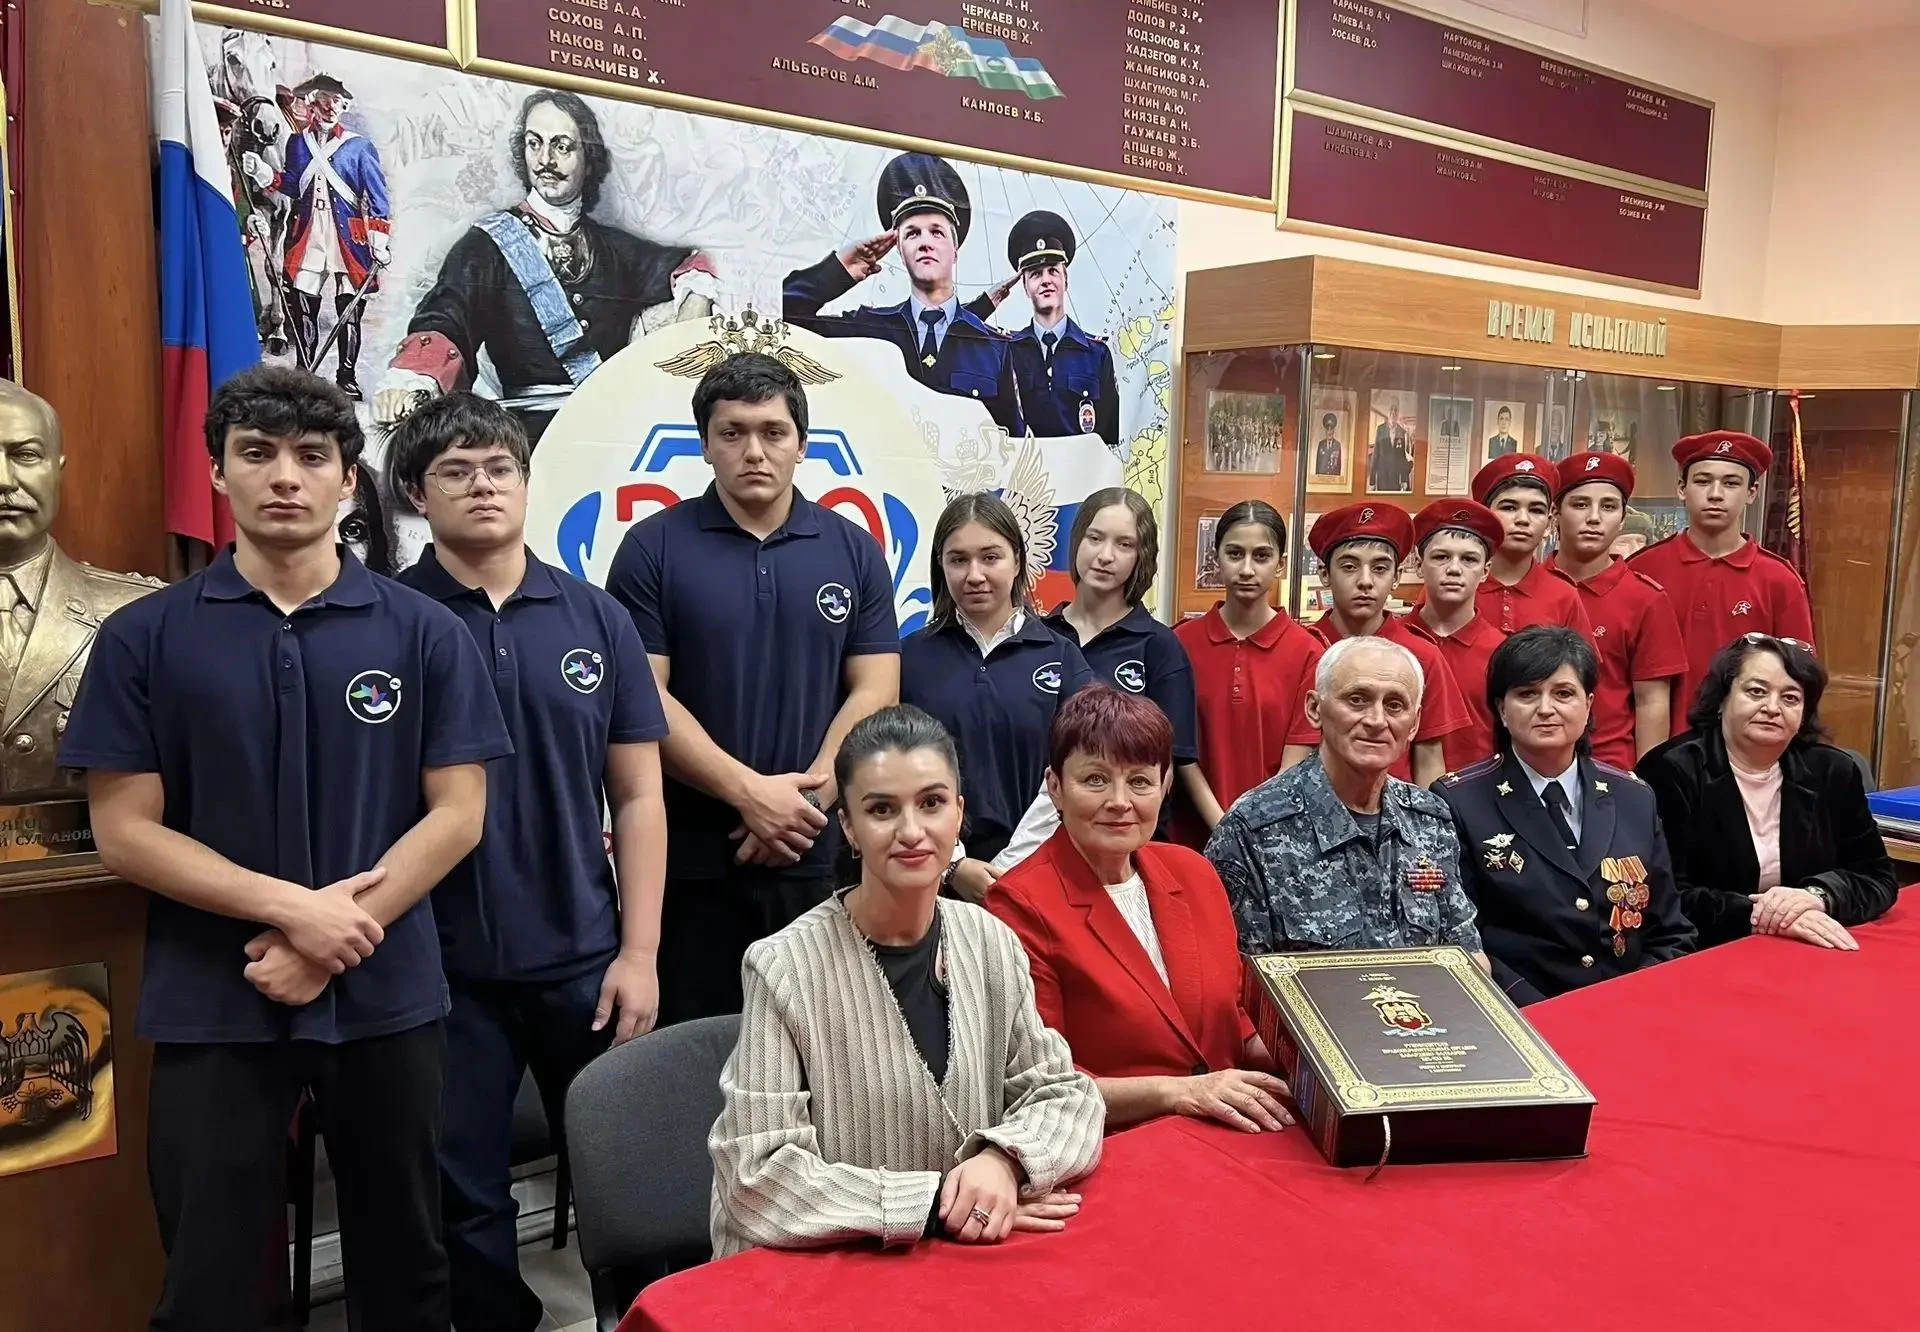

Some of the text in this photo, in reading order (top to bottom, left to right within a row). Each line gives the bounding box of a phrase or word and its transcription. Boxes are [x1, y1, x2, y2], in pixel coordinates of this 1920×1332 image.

[549, 8, 647, 41] СОХОВ А.П.
[614, 2, 647, 20] А.А.
[962, 3, 1043, 32] ЧЕРКАЕВ Ю.Х.
[1127, 9, 1189, 35] ДОЛОВ Р.З.
[962, 17, 1033, 45] ЕРКЕНОВ Х.
[1127, 26, 1204, 56] КОДЗОКОВ К.Х.
[549, 29, 648, 62] НАКОВ М.О.
[1126, 43, 1202, 71] ХАДЗЕГОВ К.Х.
[550, 50, 666, 85] ГУБАЧИЕВ Х.
[772, 57, 880, 89] АЛЬБОРОВ А.М.
[1125, 60, 1210, 89] ЖАМБИКОВ З.А.
[1124, 76, 1178, 98] ШХАГУМОВ
[962, 96, 1045, 123] КАНЛОЕВ Х.Б.
[1124, 93, 1187, 116] БУКИН А.Ю.
[1124, 108, 1192, 132] КНЯЗЕВ А.Н.
[1123, 140, 1181, 161] АПШЕВ Ж.
[1124, 124, 1201, 149] ГАУЖАЕВ З.Б.
[1124, 154, 1188, 176] БЕЗИРОВ Х.
[1487, 299, 1668, 358] ВРЕМЯ ИСПЫТАНИЙ
